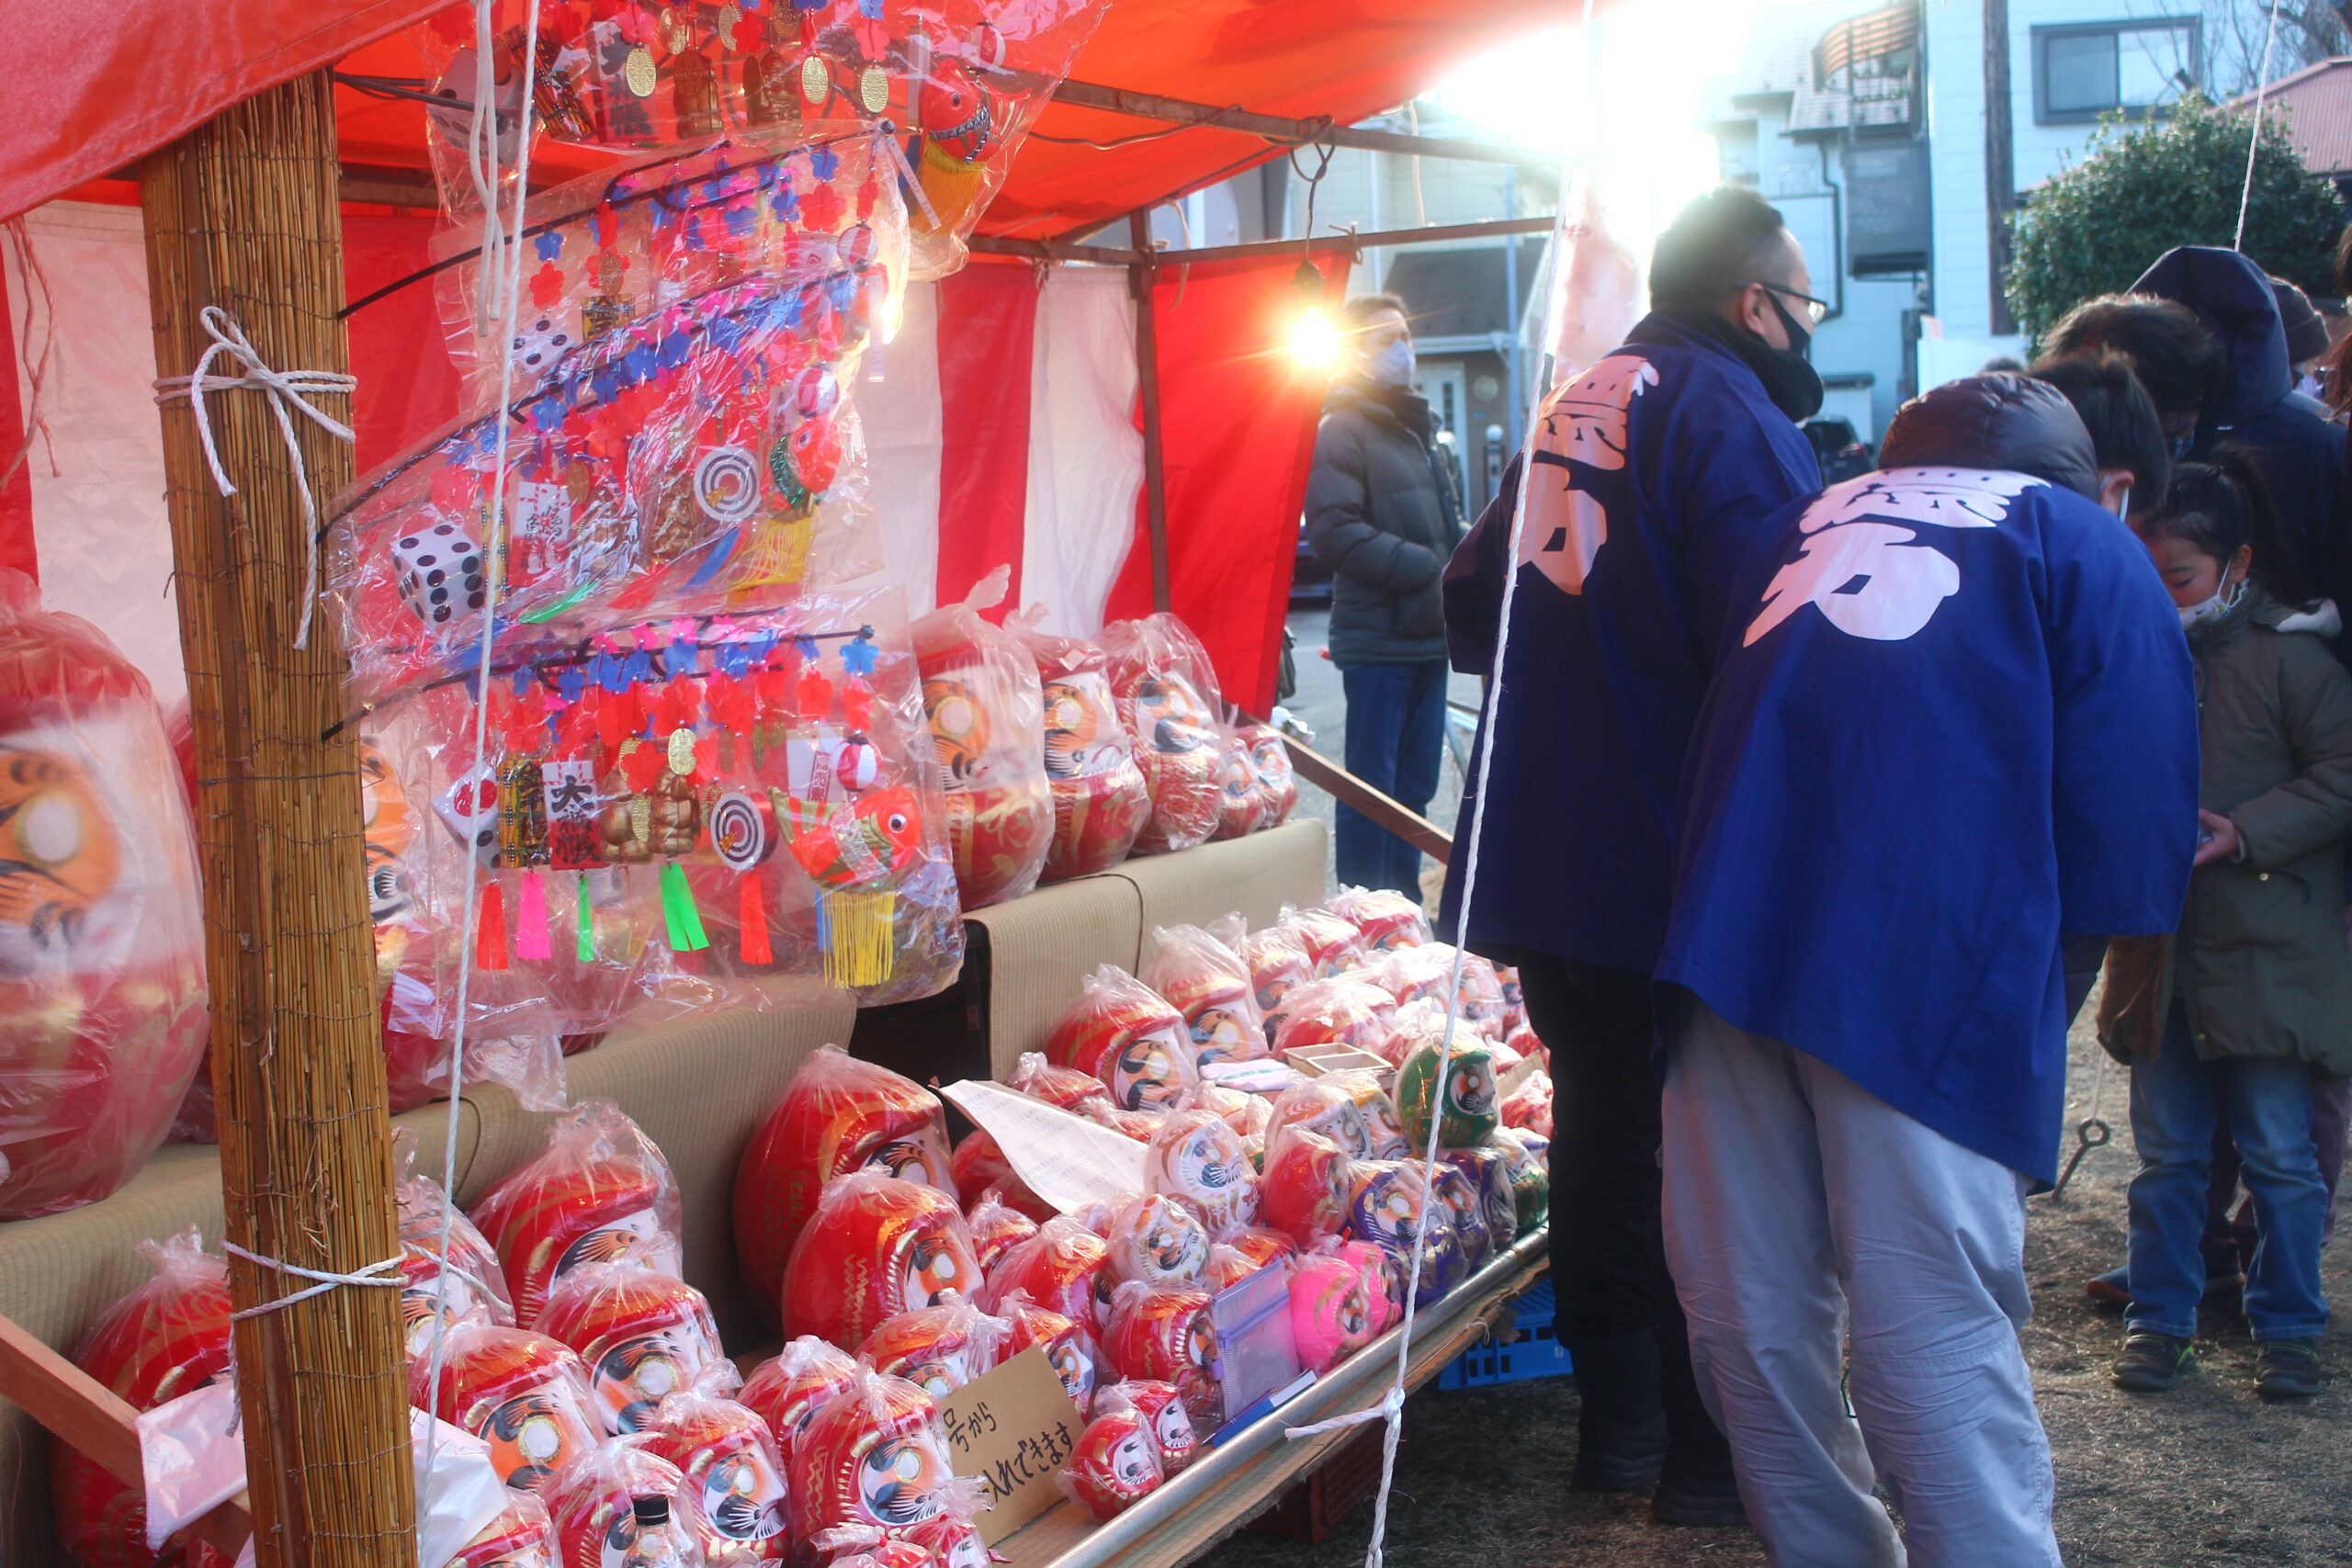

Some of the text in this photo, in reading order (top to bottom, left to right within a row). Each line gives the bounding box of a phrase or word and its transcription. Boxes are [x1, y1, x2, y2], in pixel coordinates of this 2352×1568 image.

[943, 1402, 997, 1452] 号から
[977, 1421, 1073, 1512] 入れできます
